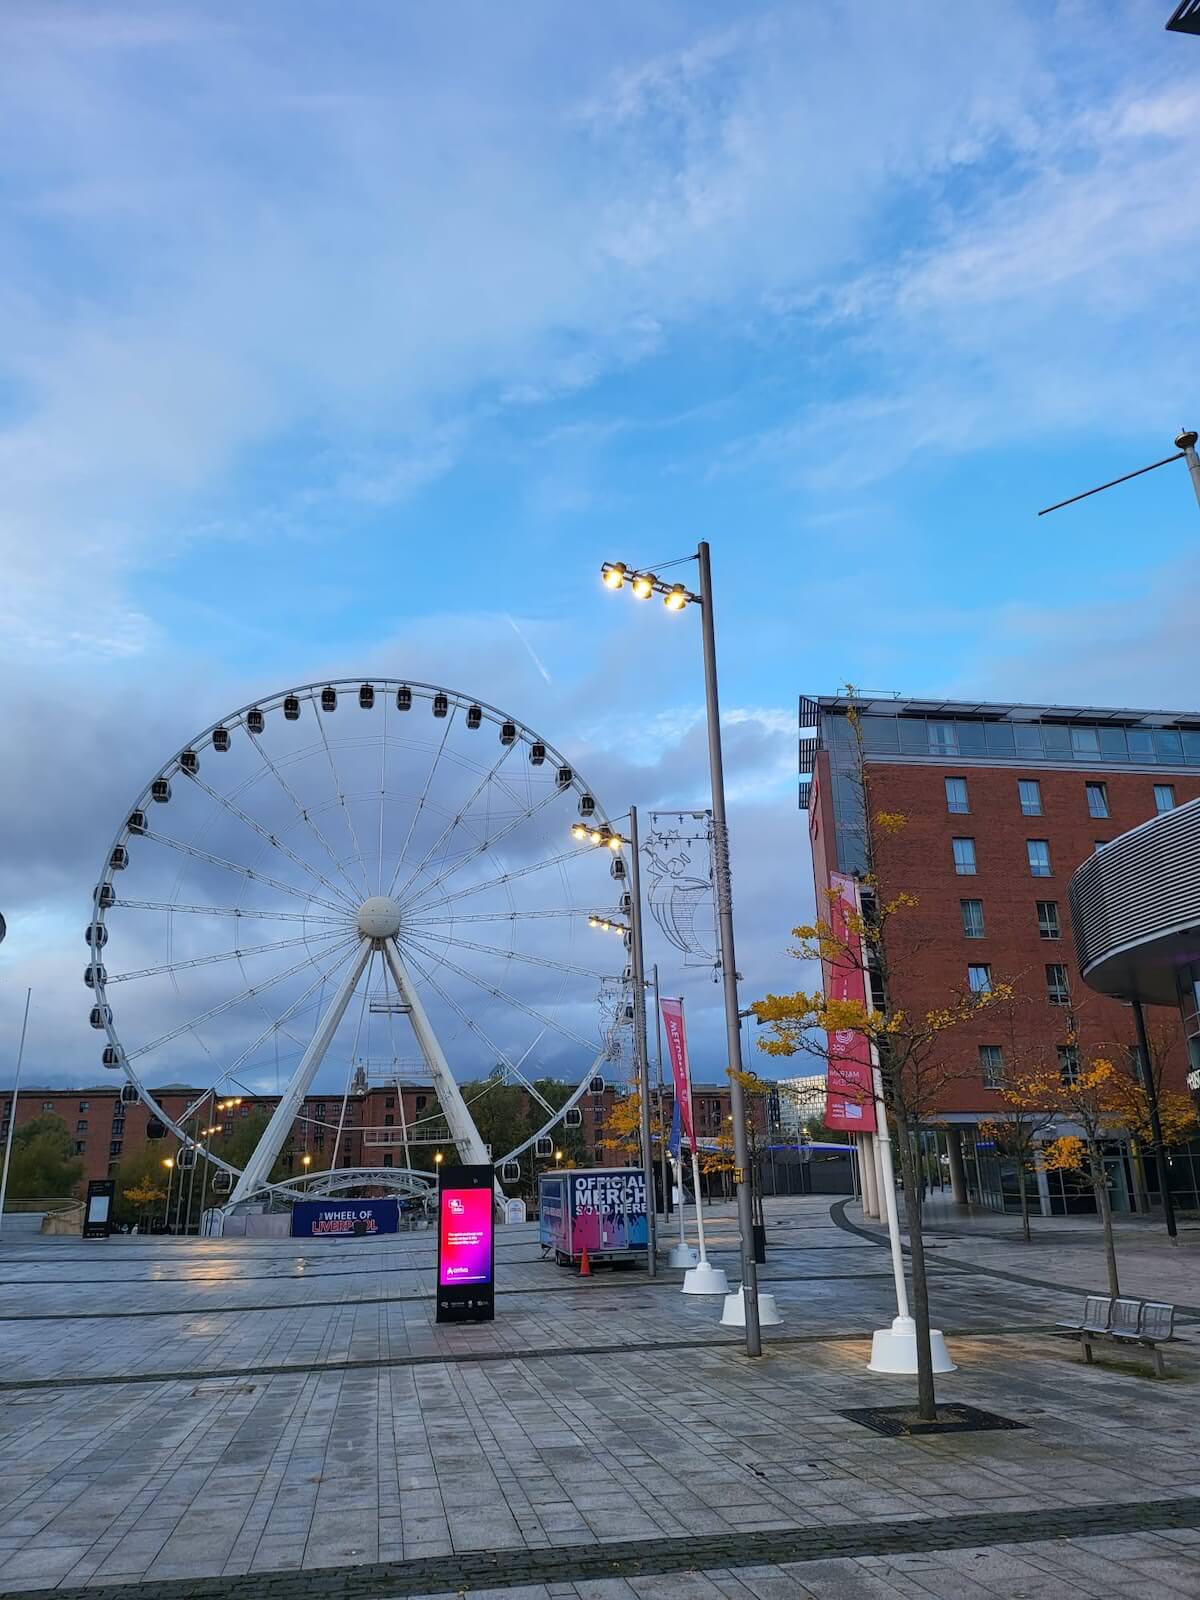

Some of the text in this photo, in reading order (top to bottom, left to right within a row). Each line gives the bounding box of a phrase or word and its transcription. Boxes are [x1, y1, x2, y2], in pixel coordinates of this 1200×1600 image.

[575, 1175, 646, 1190] OFFICIAL
[575, 1188, 647, 1206] MERCH
[324, 1212, 357, 1220] WHEEL
[359, 1210, 373, 1219] OF
[575, 1202, 648, 1216] SOLD HERE
